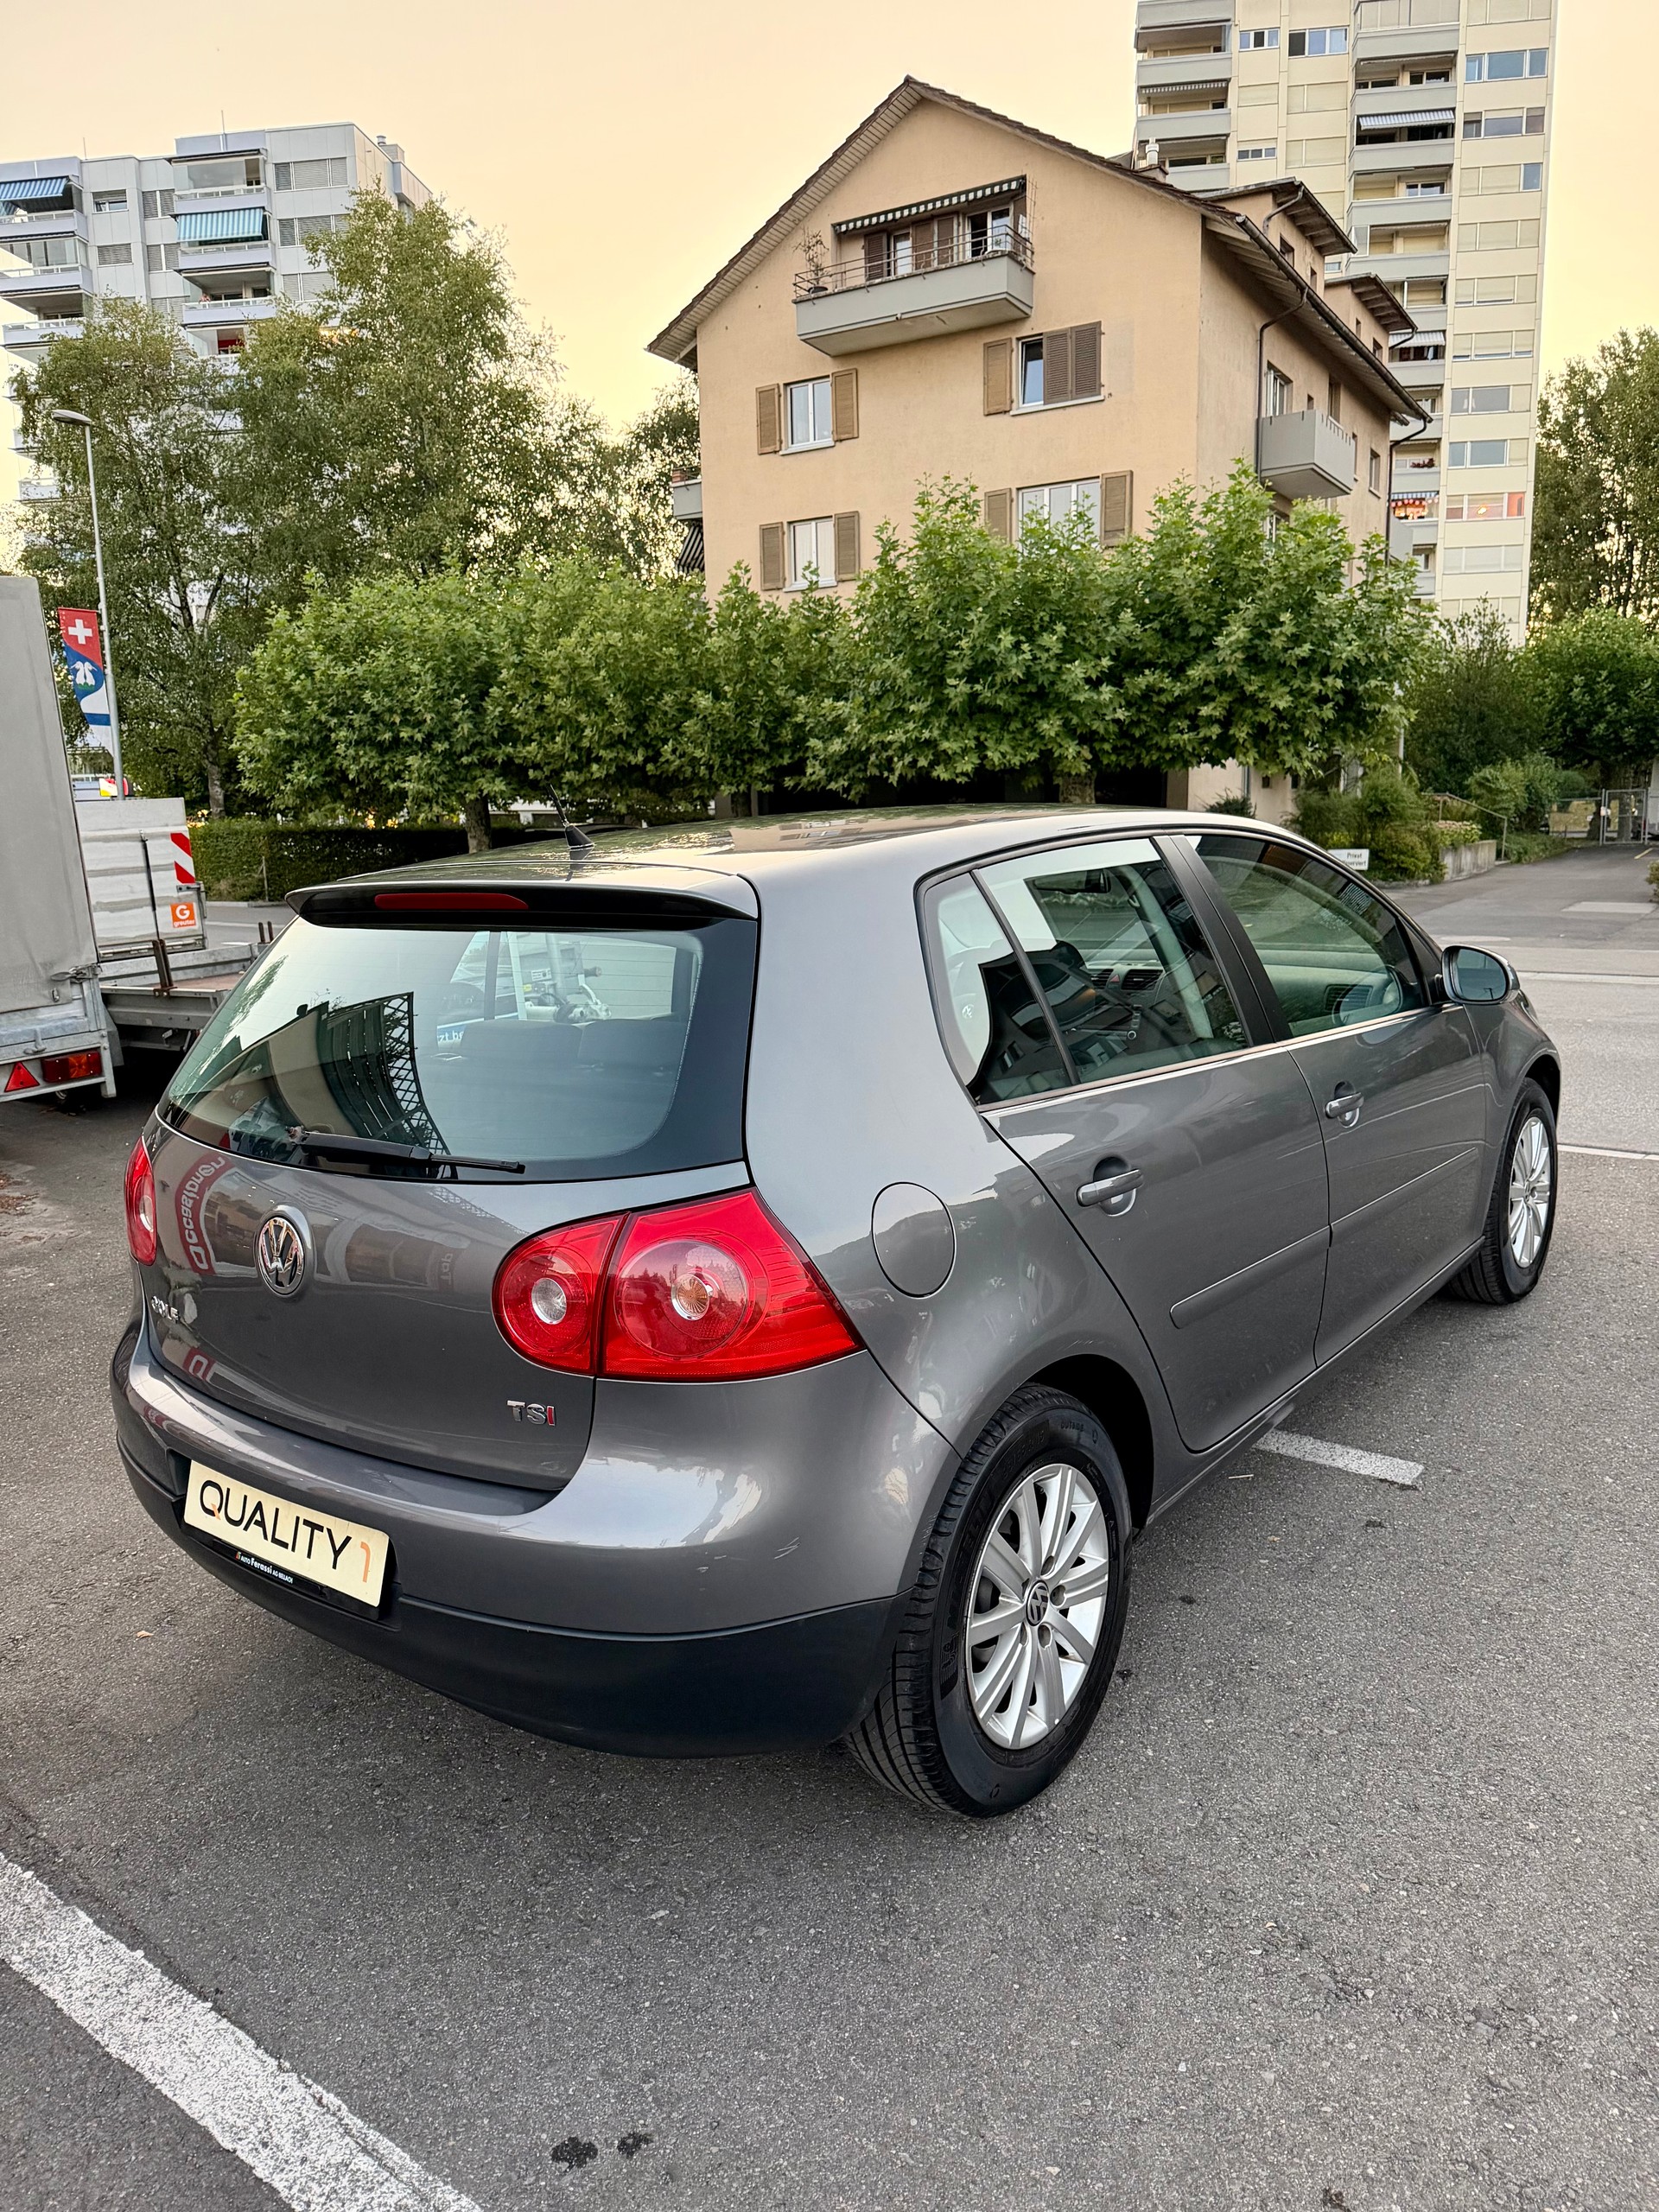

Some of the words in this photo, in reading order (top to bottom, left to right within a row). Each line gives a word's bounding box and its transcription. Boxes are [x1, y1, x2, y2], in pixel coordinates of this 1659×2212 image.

[175, 905, 190, 920] G
[507, 1400, 556, 1427] TSI
[200, 1479, 353, 1570] QUALITY
[359, 1541, 372, 1583] 1
[251, 1557, 272, 1574] Ferassi
